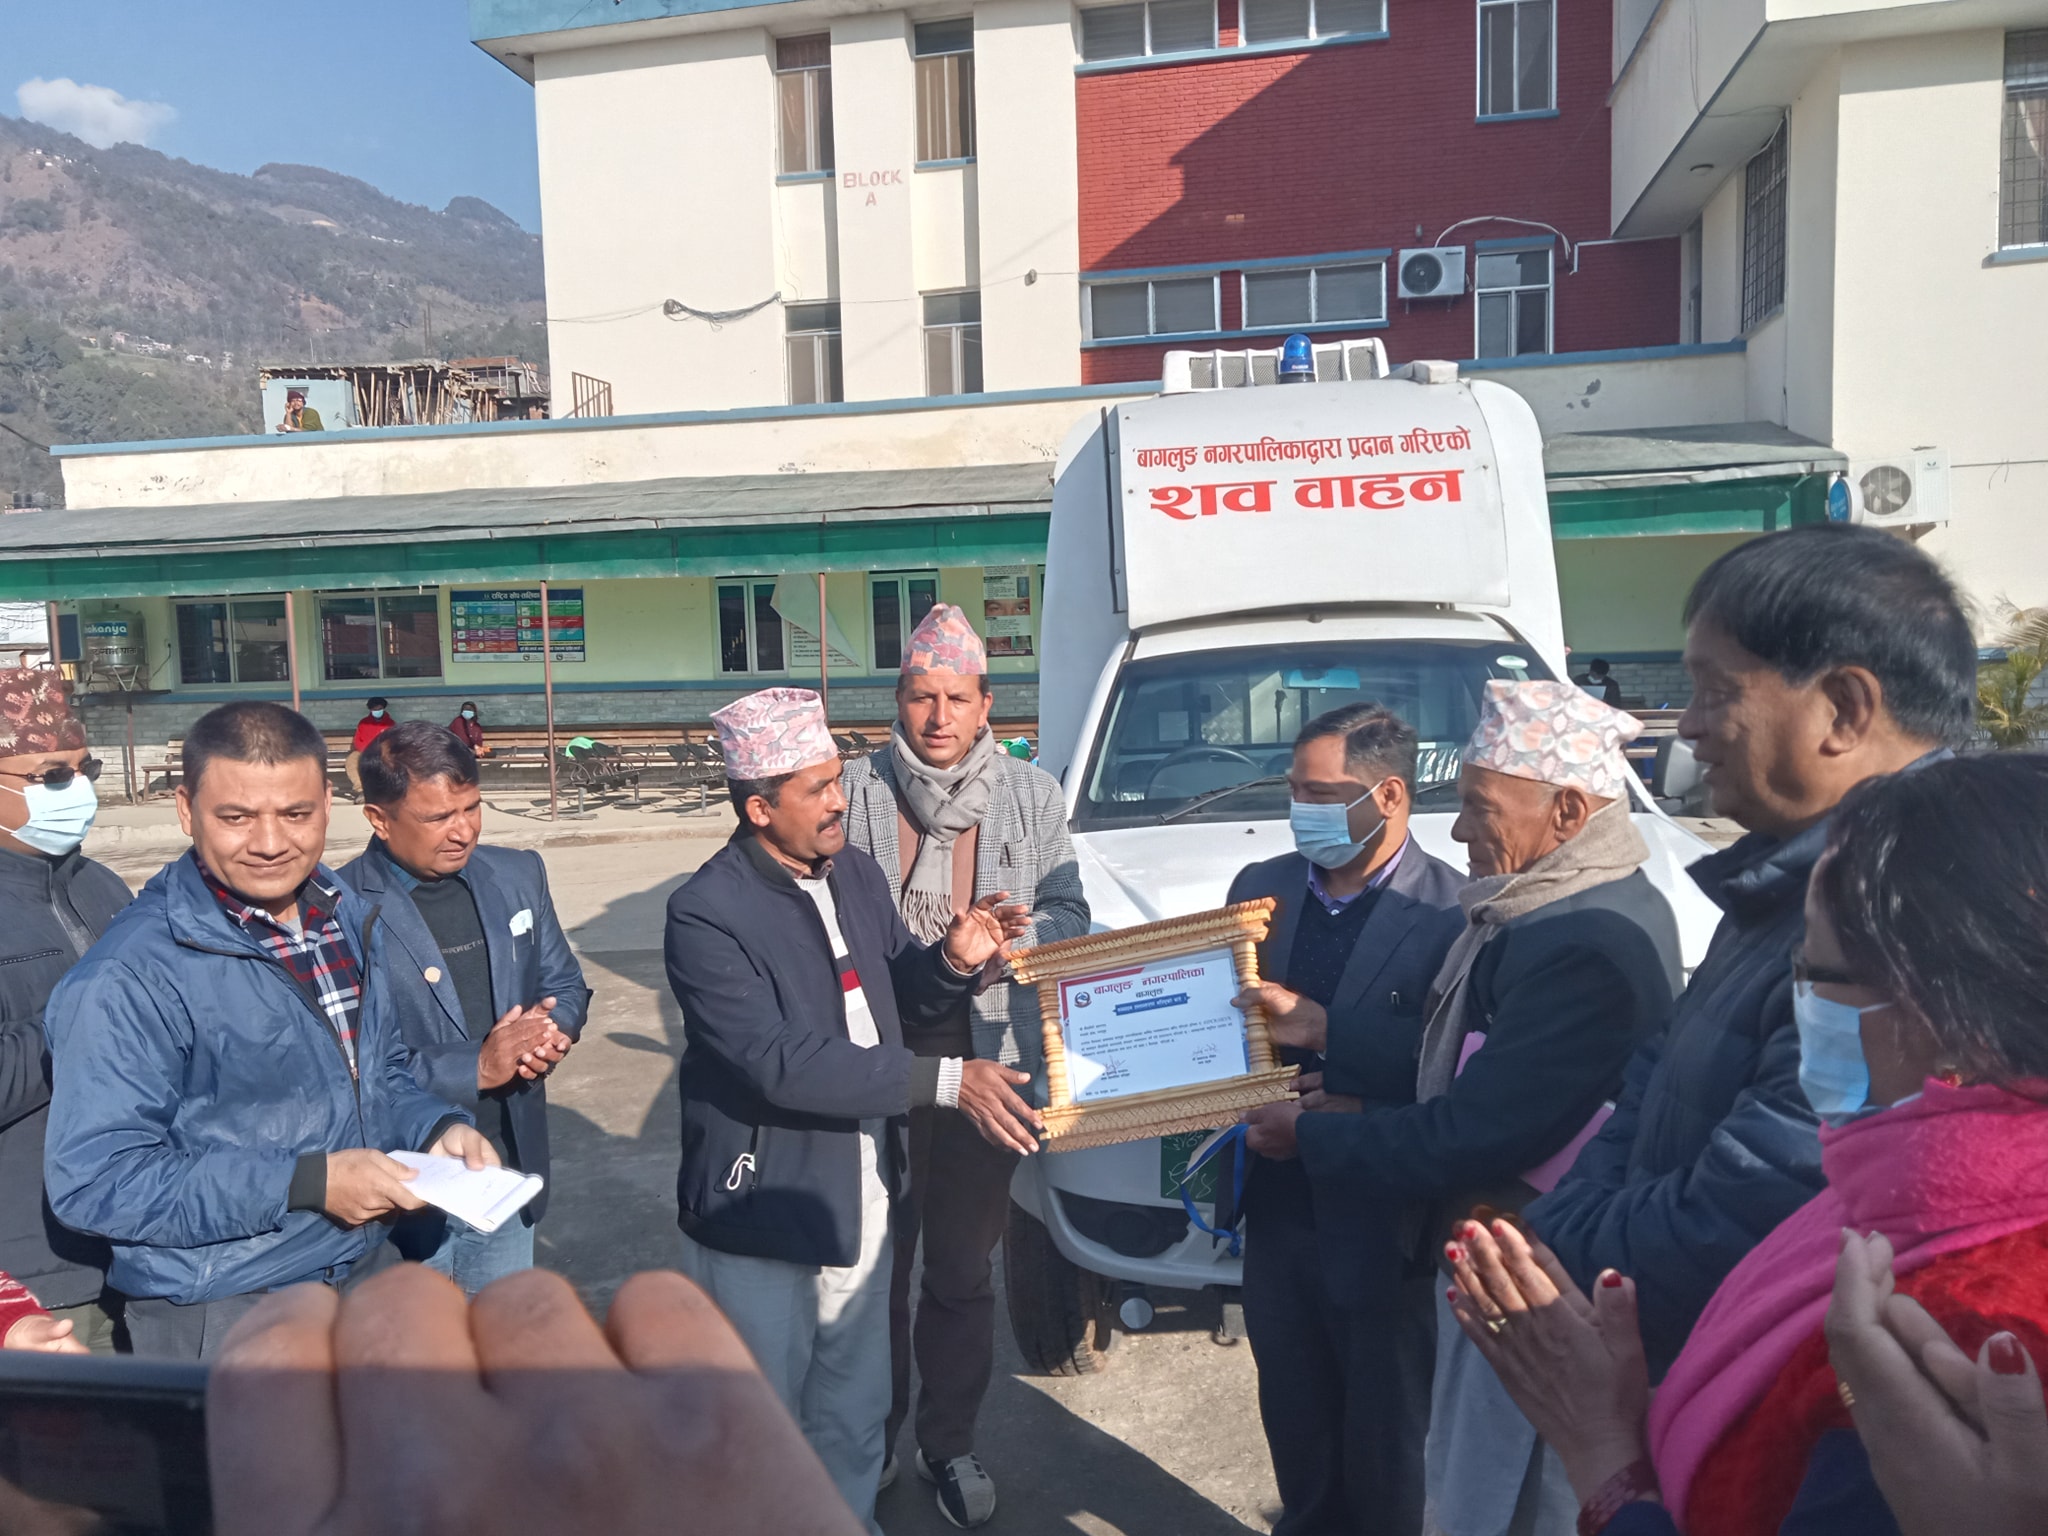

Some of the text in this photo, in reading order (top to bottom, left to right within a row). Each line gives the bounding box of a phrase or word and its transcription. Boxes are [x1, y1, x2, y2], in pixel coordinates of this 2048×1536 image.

[843, 169, 903, 188] BLOCK
[865, 191, 877, 207] A
[1136, 446, 1198, 472] बागलुङ
[1347, 435, 1395, 459] प्रदान
[1397, 425, 1471, 454] गरिएको
[1149, 469, 1465, 520] शव वाहन
